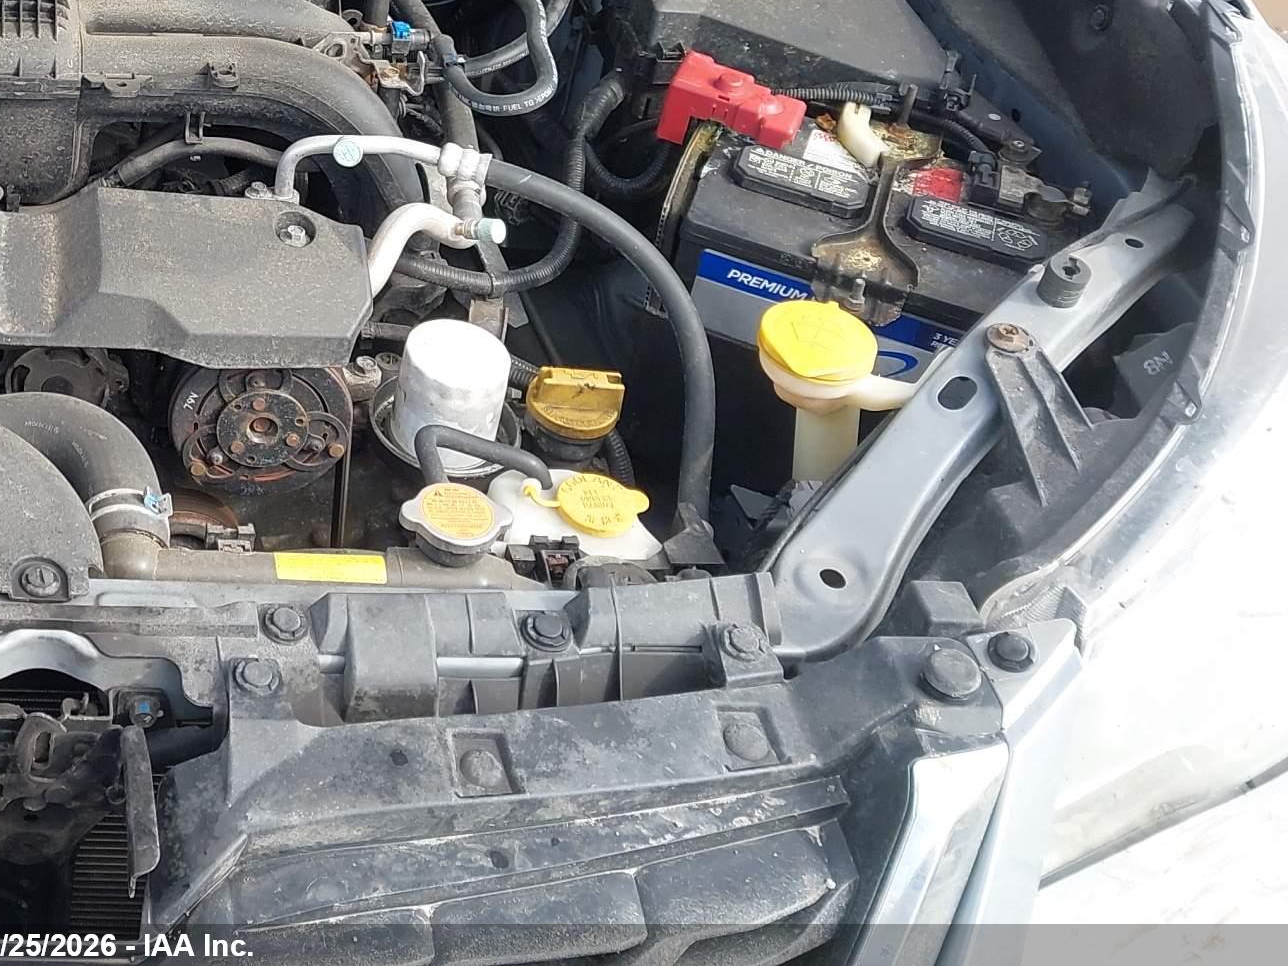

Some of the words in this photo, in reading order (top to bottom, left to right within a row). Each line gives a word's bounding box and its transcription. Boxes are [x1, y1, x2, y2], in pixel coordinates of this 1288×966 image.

[503, 103, 523, 112] FUEL
[524, 99, 535, 108] TO
[726, 268, 809, 301] PREMIUM
[943, 335, 960, 347] YE
